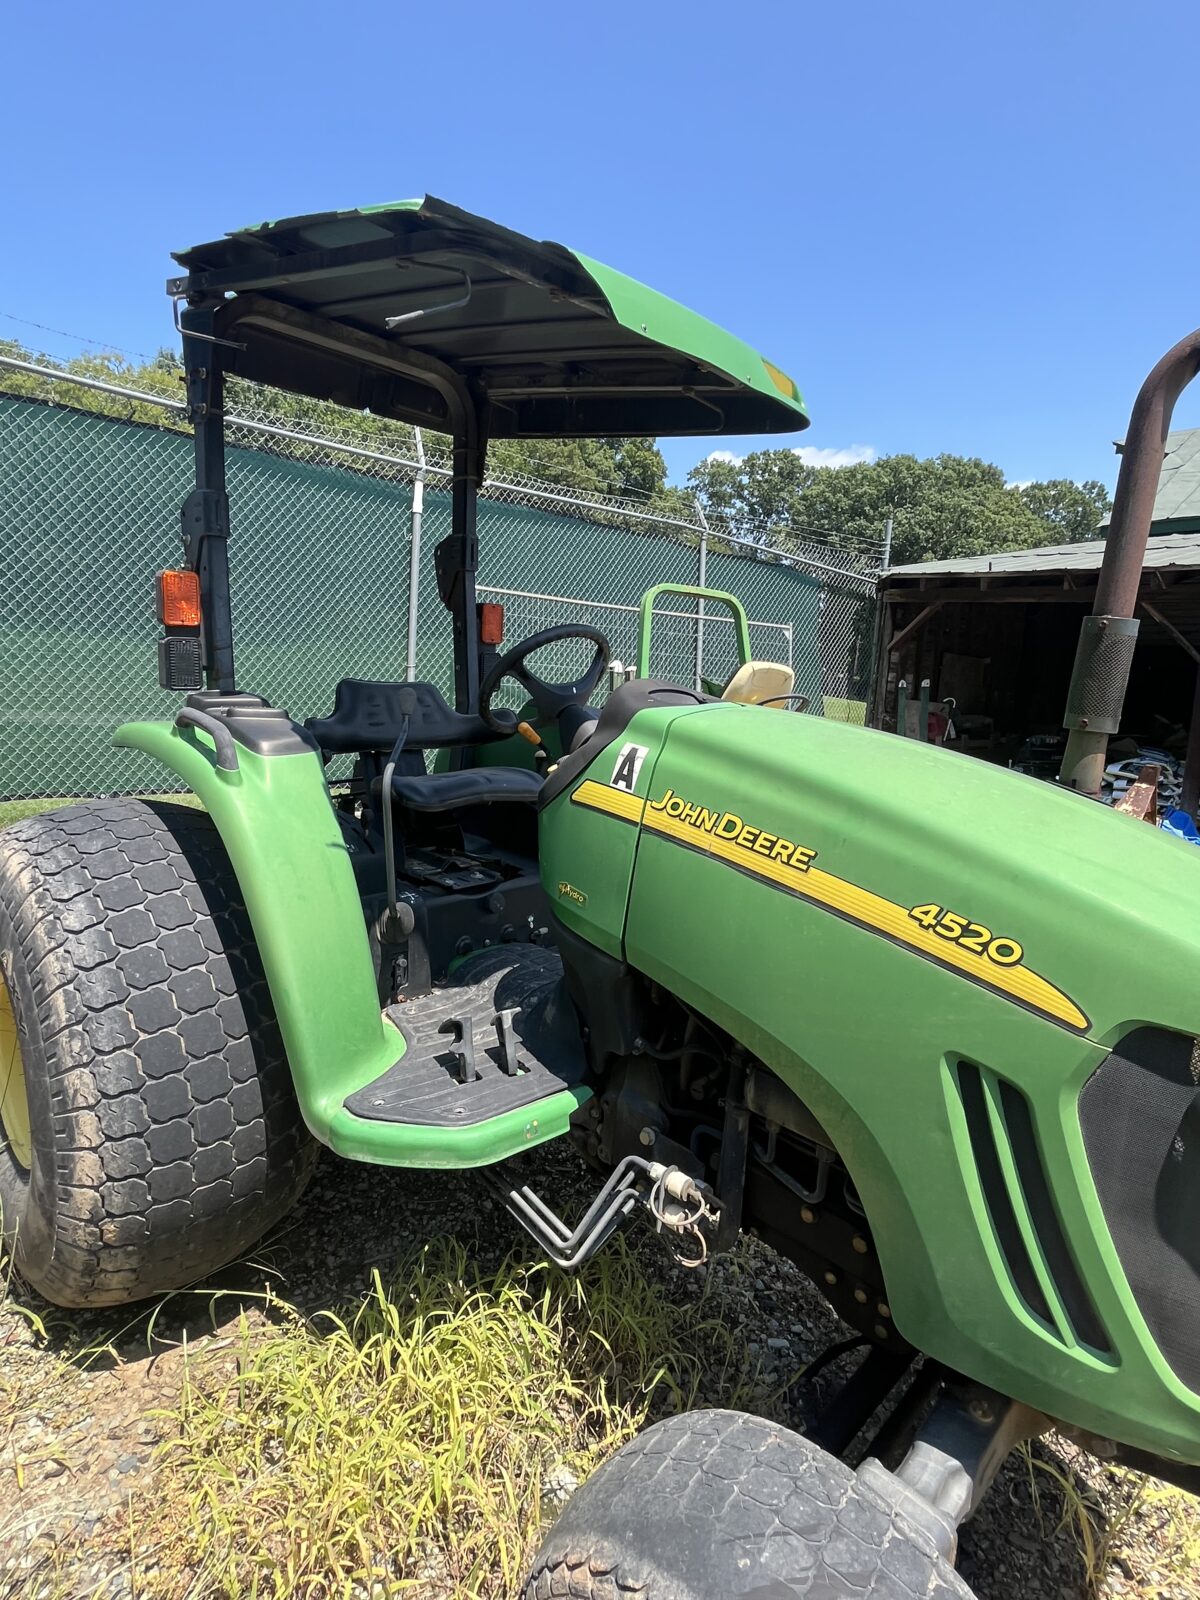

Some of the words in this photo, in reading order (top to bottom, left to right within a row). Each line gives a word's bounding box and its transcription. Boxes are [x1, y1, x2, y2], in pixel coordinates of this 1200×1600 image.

[612, 746, 638, 790] A
[650, 789, 718, 832] JOHN
[714, 812, 818, 872] DEERE
[908, 903, 1024, 967] 4520
